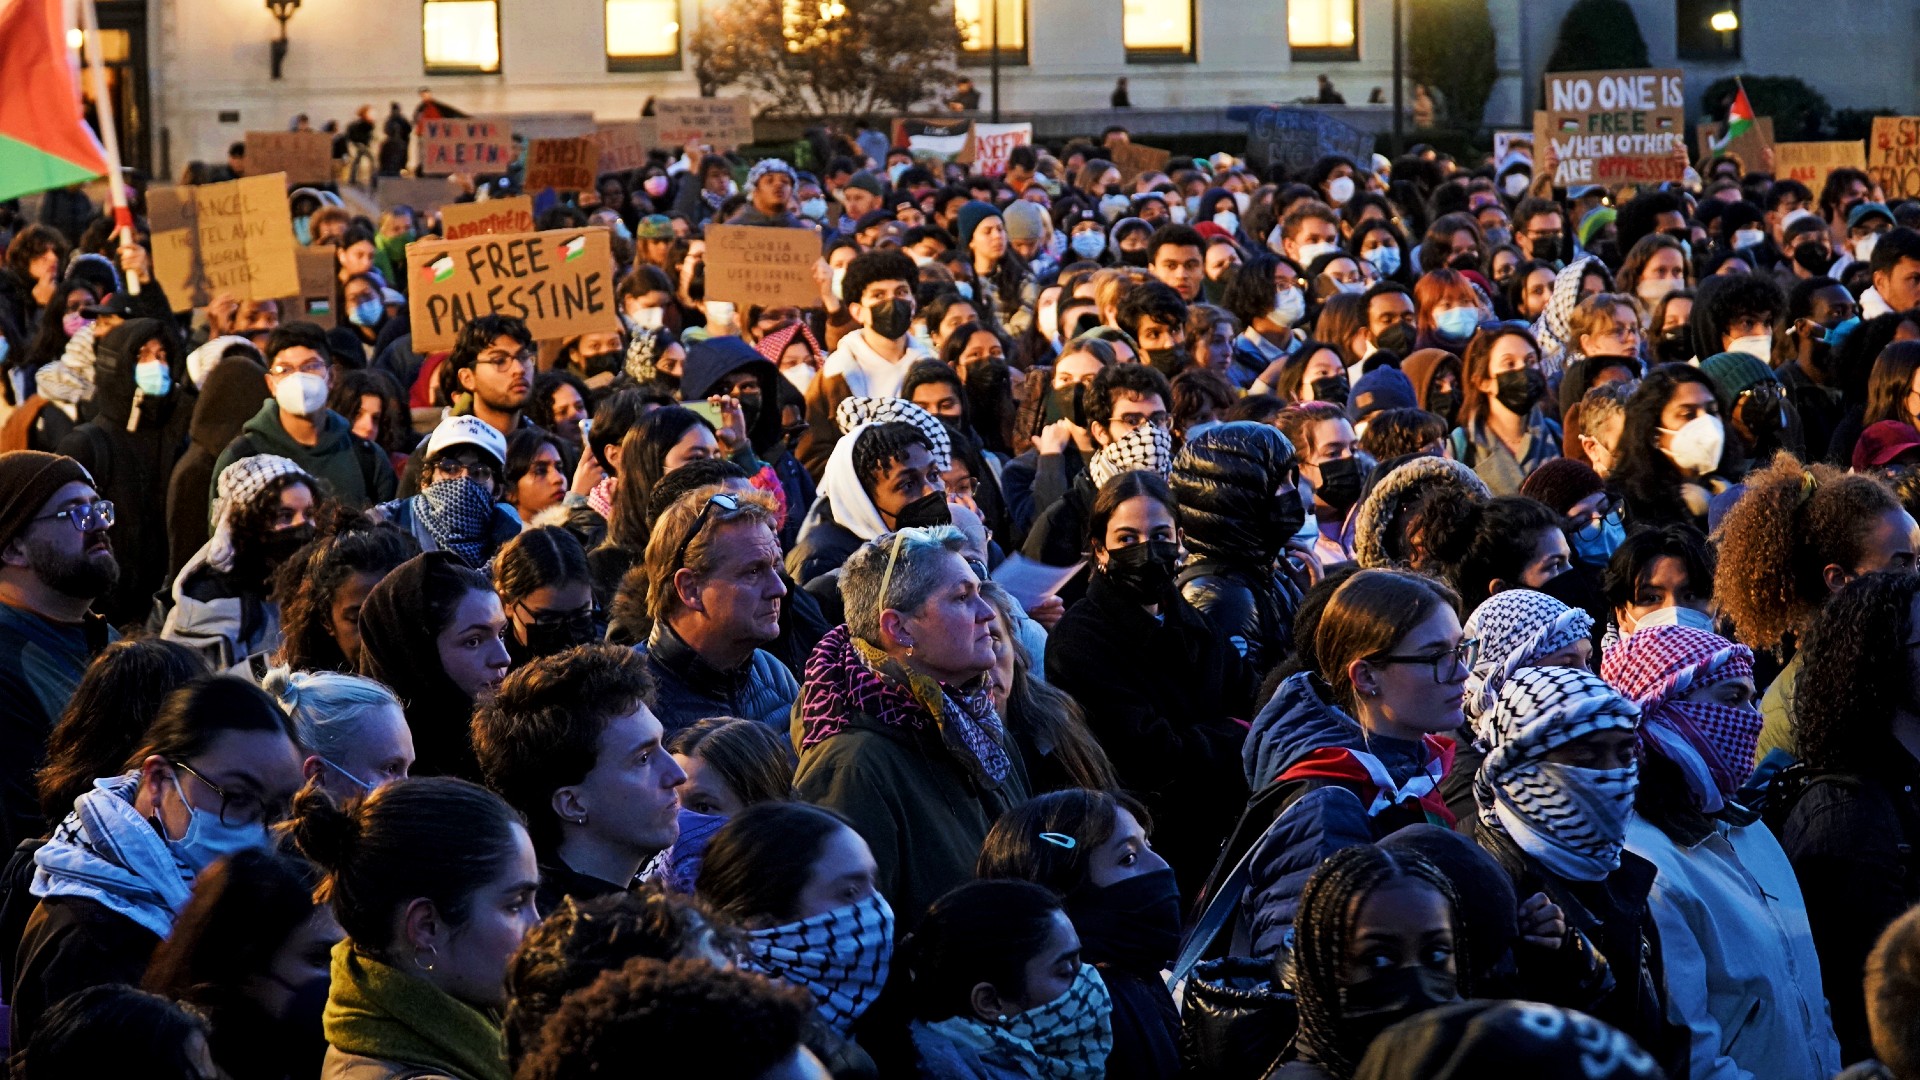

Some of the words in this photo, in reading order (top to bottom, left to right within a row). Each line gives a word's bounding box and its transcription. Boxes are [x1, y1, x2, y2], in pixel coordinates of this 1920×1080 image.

[1552, 78, 1593, 112] NO
[1598, 76, 1657, 110] ONE
[1661, 76, 1684, 107] IS
[1588, 111, 1648, 132] FREE
[1551, 134, 1614, 159] WHEN
[1554, 158, 1593, 185] ARE
[181, 194, 258, 219] CANCEL
[200, 226, 225, 245] TEL
[466, 238, 549, 285] FREE
[204, 263, 260, 290] ENTER
[426, 271, 605, 336] PALESTINE
